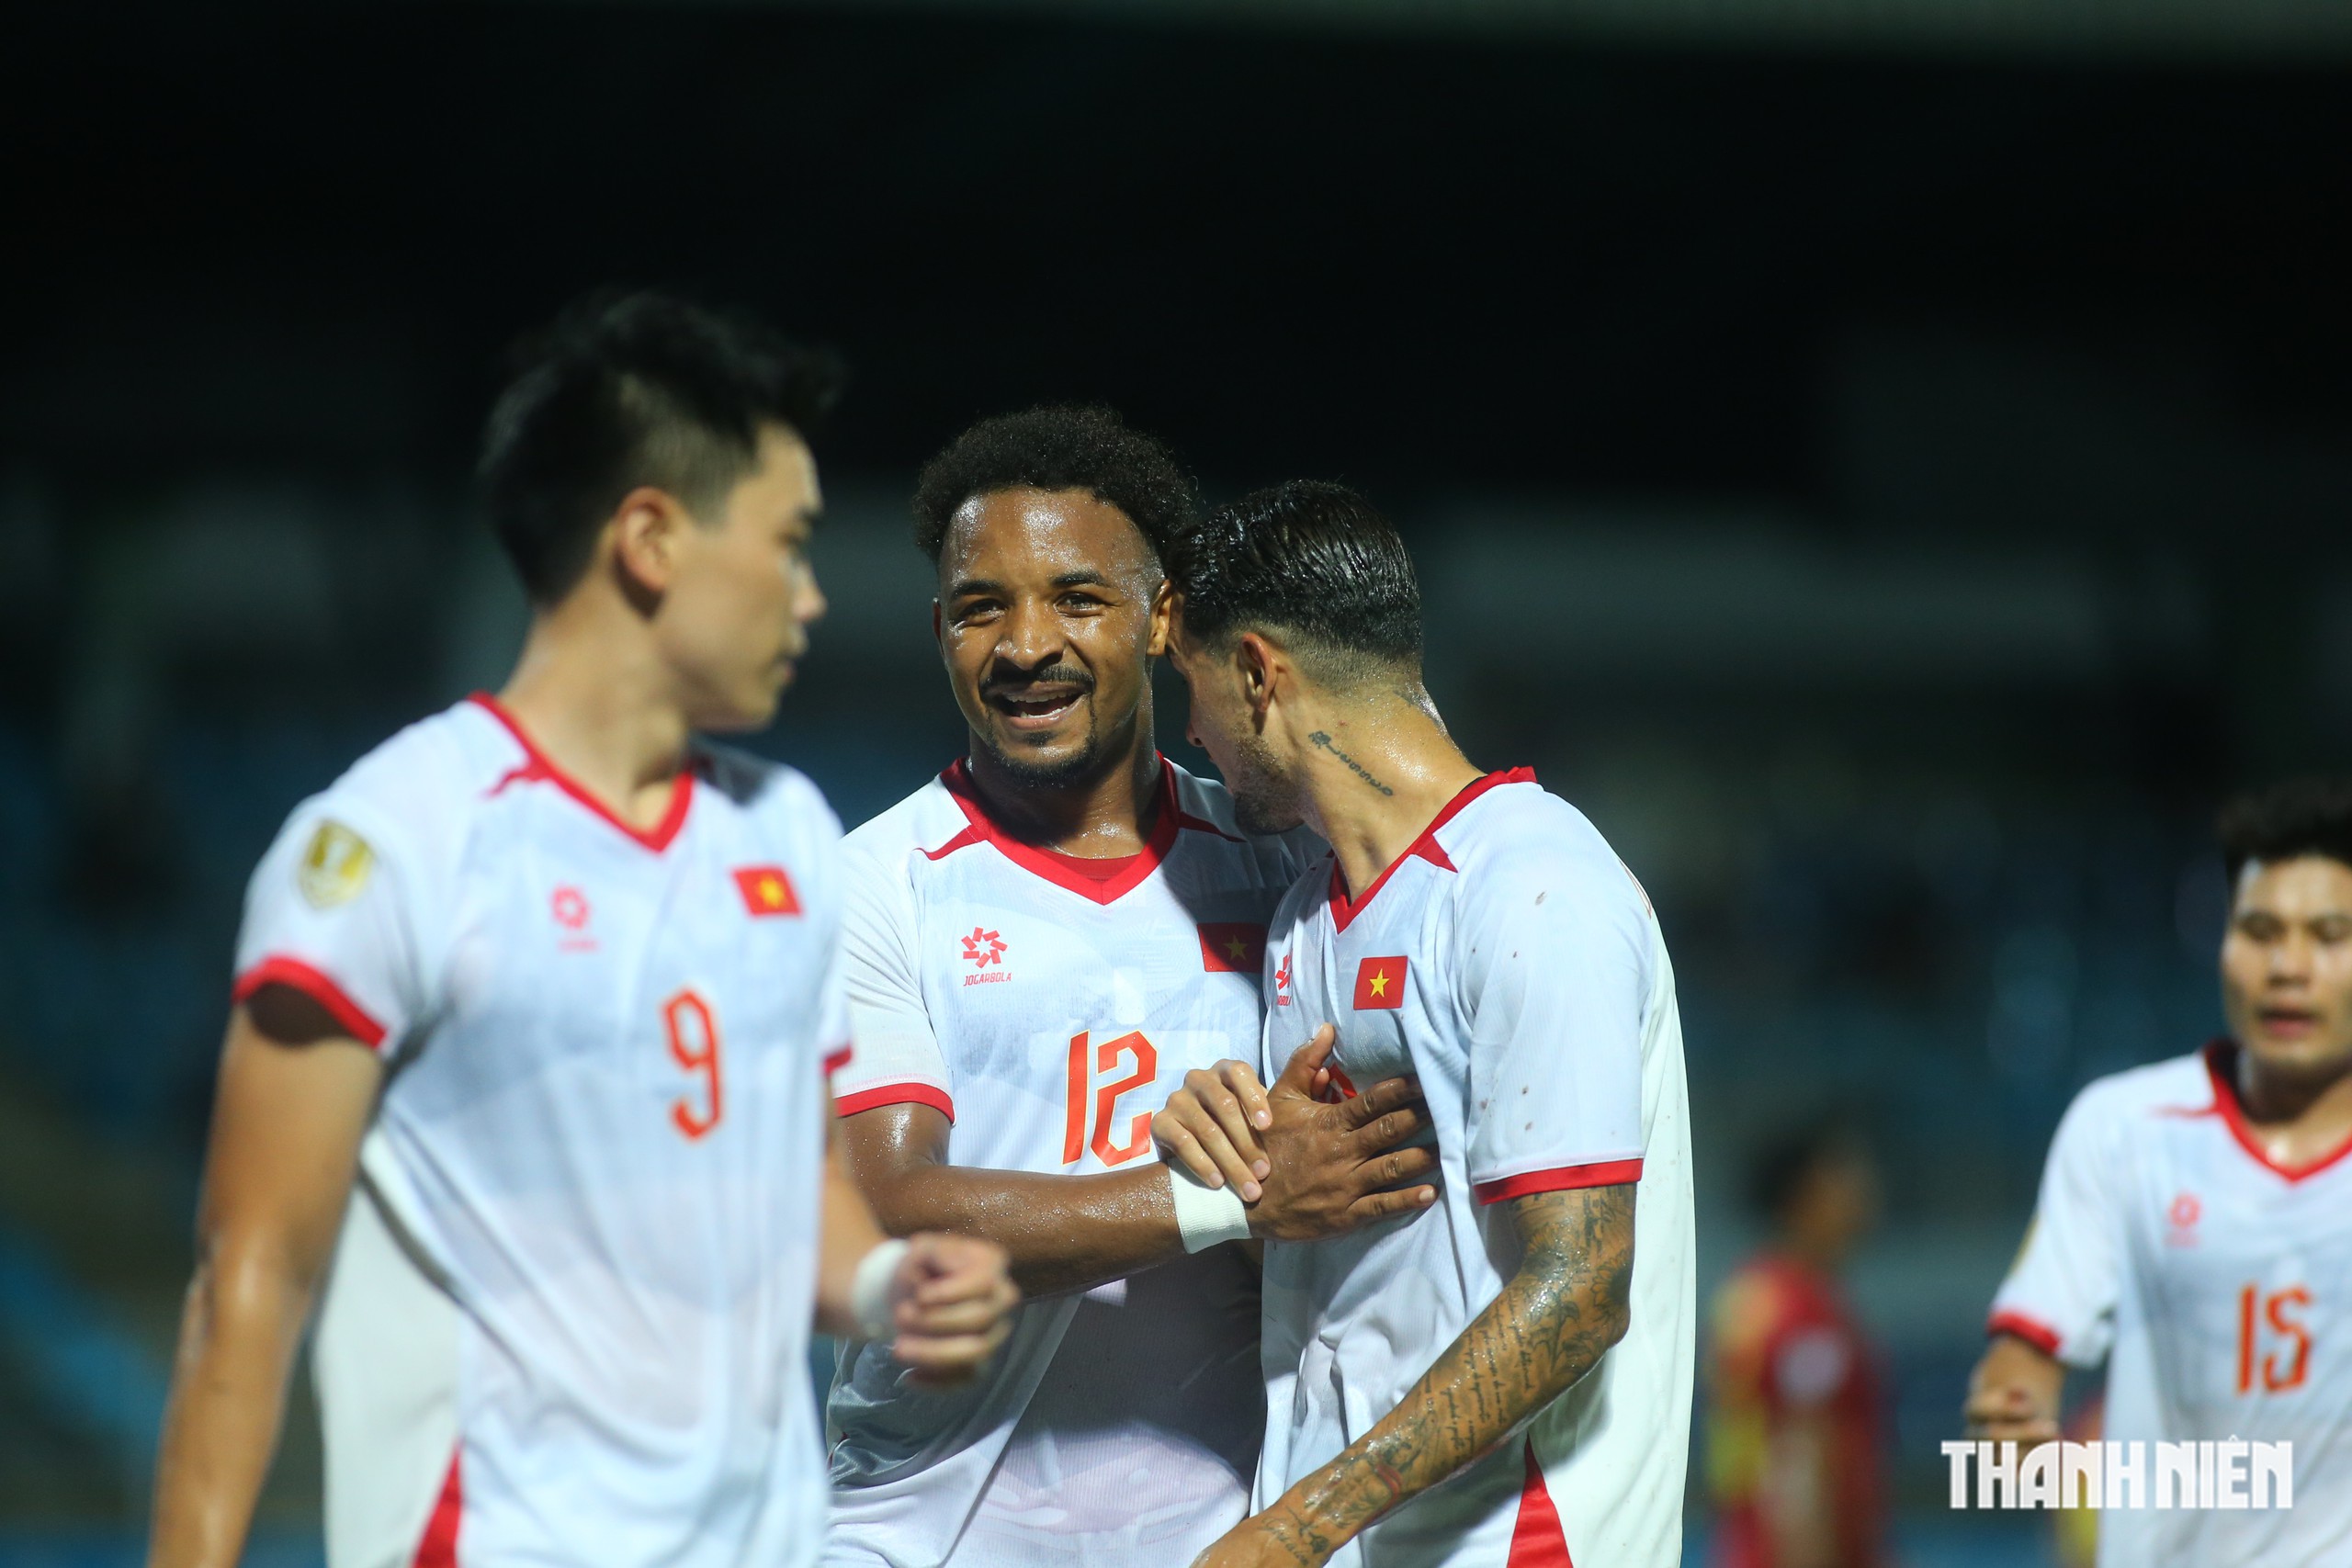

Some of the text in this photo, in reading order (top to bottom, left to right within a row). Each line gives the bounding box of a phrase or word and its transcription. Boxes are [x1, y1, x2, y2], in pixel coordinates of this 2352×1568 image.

[963, 972, 1012, 987] JOGARBOLA
[661, 987, 723, 1140] 9
[1062, 1029, 1158, 1168] 12
[2236, 1282, 2314, 1395] 15
